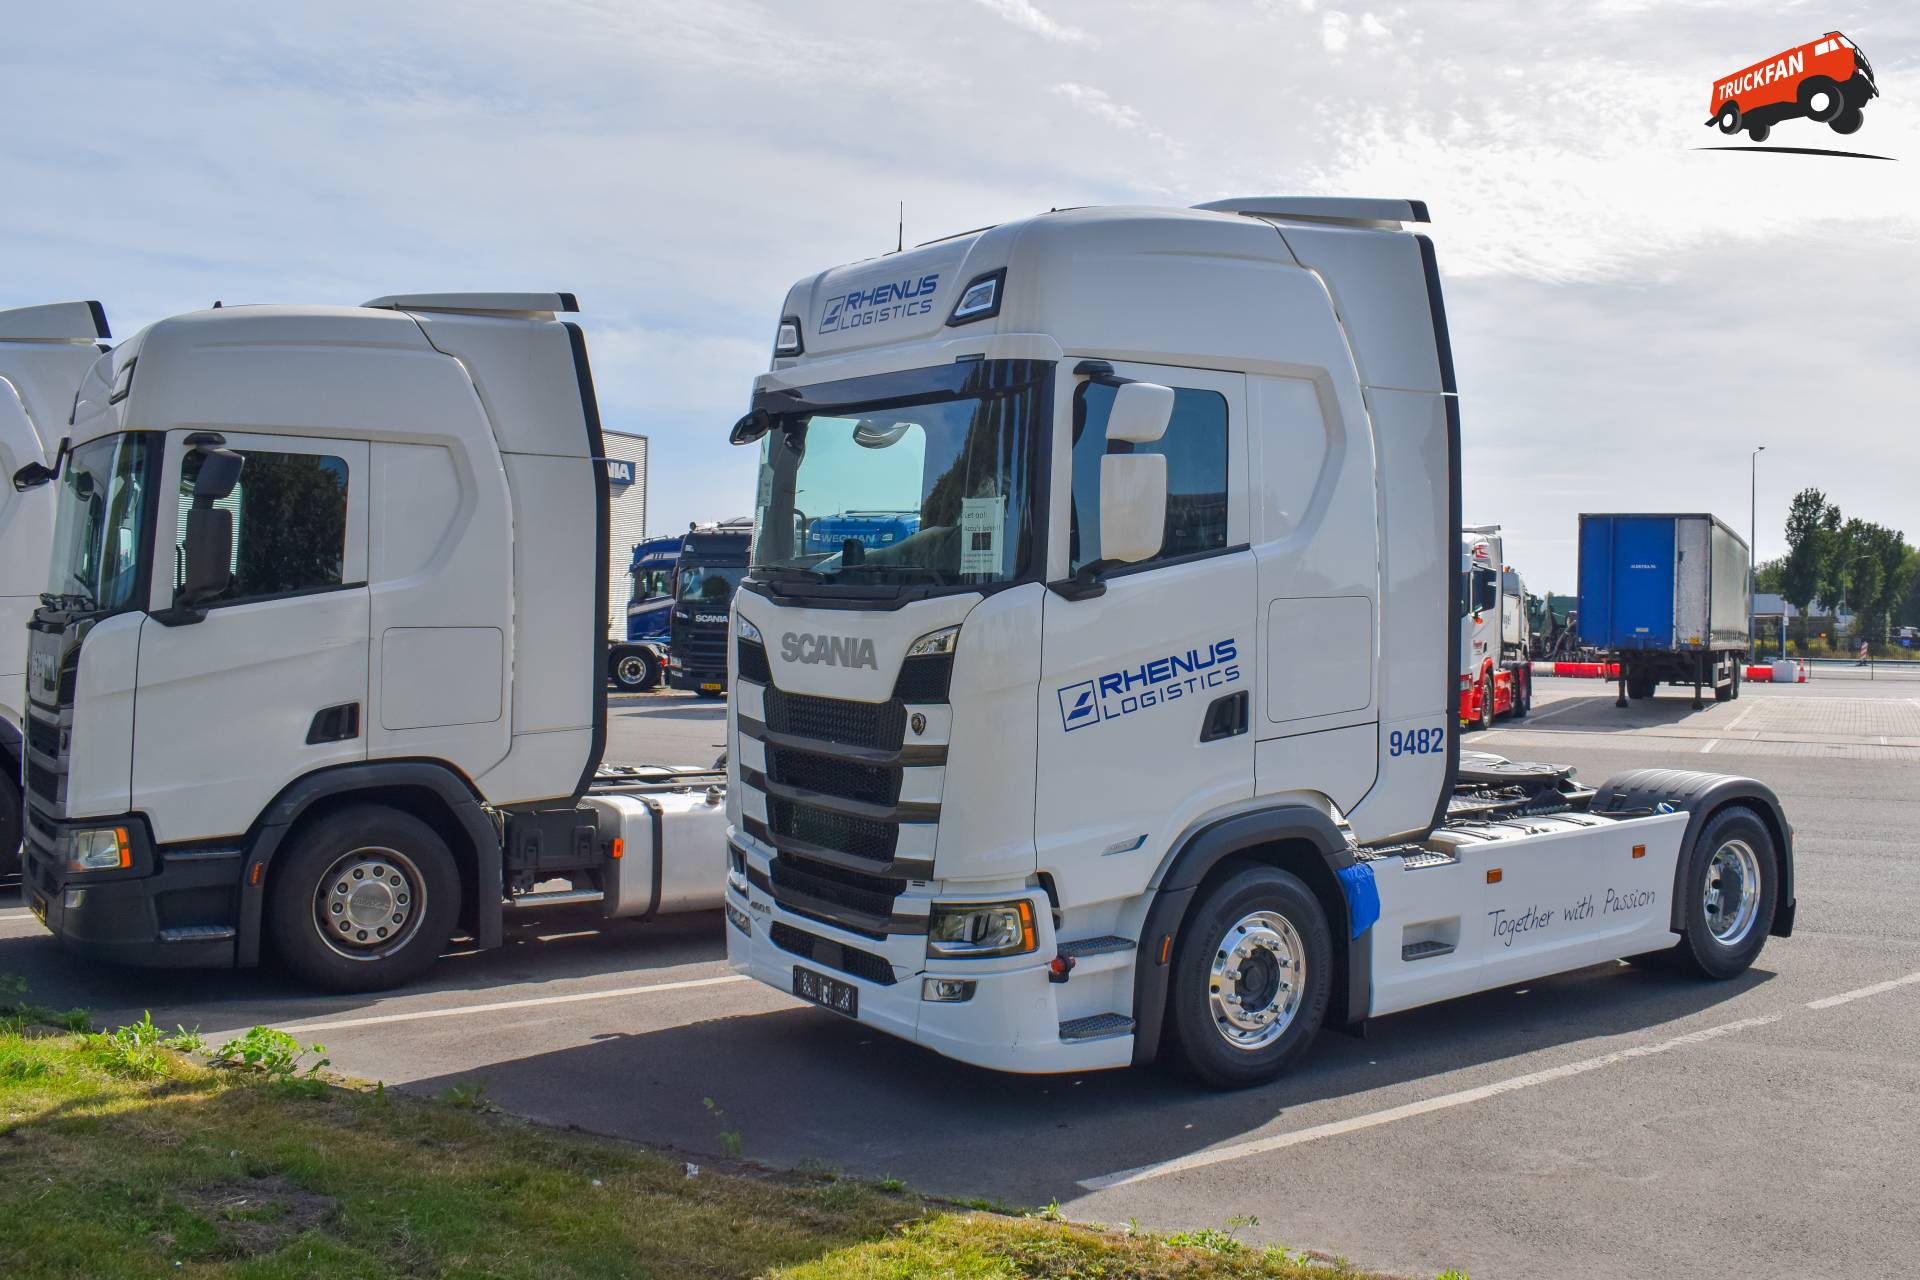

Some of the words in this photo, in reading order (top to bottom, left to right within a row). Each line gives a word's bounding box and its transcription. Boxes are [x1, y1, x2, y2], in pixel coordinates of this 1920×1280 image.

[844, 274, 940, 312] RHENUS
[840, 299, 933, 330] LOGISTICS
[607, 461, 631, 480] NIA
[695, 614, 729, 623] SCANIA
[780, 632, 879, 671] SCANIA
[1099, 638, 1237, 698] RHENUS
[1103, 664, 1241, 720] LOGISTICS
[1389, 727, 1444, 757] 9482
[1488, 905, 1555, 947] Together
[1564, 894, 1594, 922] with
[1603, 888, 1656, 915] Passion
